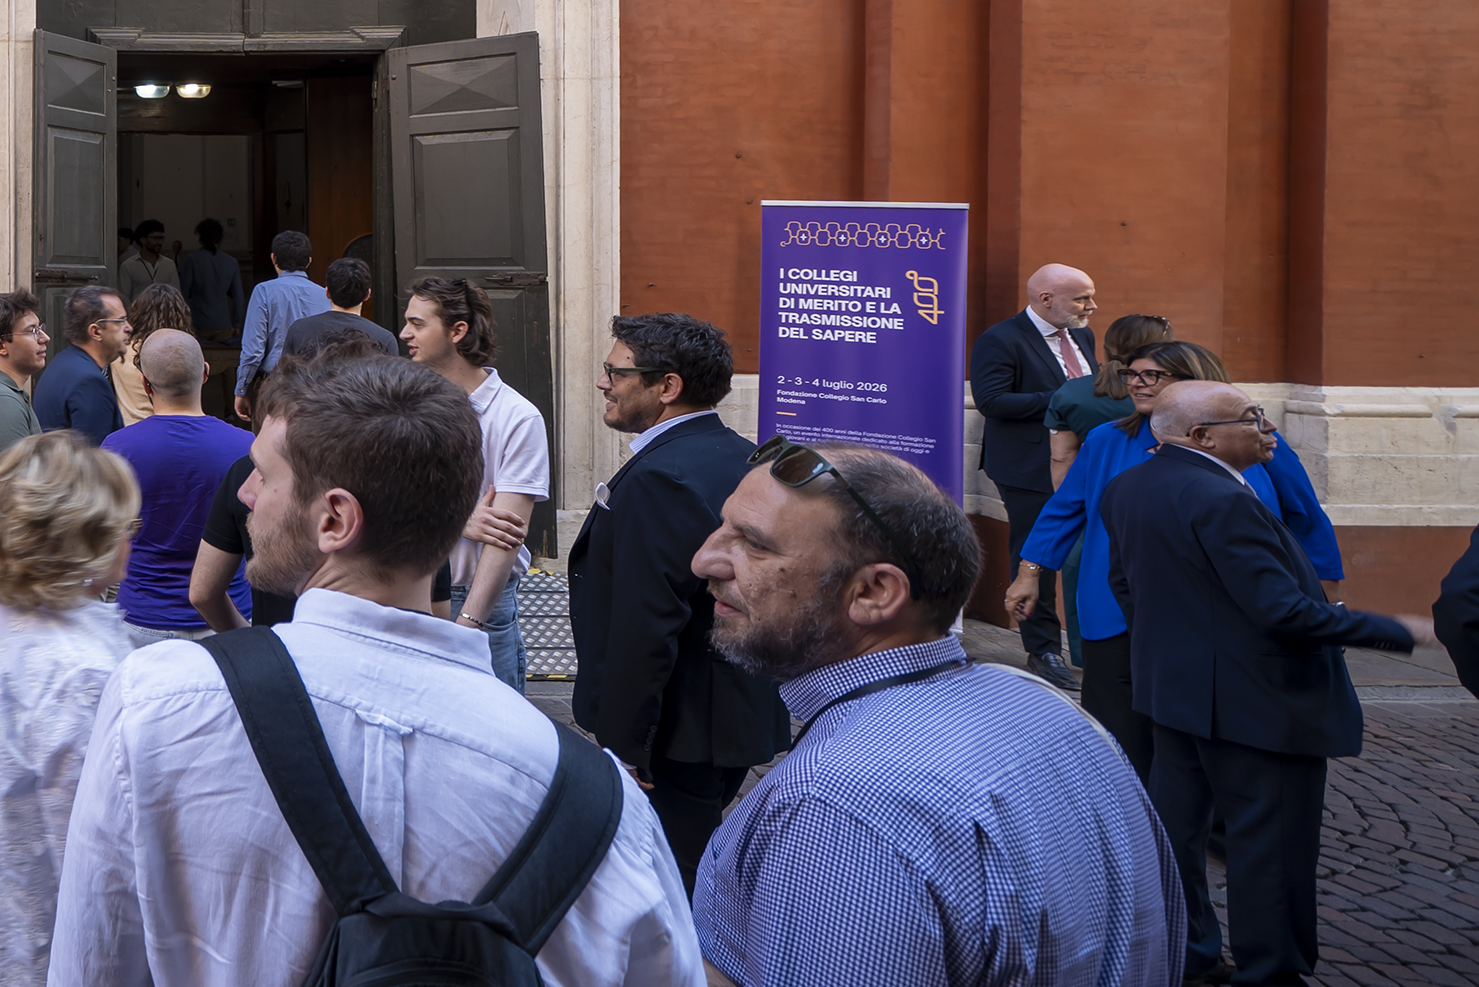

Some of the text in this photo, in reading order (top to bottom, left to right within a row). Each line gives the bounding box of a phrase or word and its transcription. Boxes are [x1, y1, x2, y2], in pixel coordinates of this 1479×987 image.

[780, 268, 858, 282] I COLLEGI
[779, 283, 891, 299] UNIVERSITARI
[779, 297, 902, 314] DI MERITO E LA
[778, 312, 904, 330] TRASMISSIONE
[778, 327, 877, 343] DEL SAPERE
[777, 375, 785, 384] 2
[794, 377, 802, 385] 3
[812, 378, 820, 386] 4
[822, 379, 854, 390] luglio
[856, 381, 888, 392] 2026
[777, 389, 817, 398] Fondazione
[819, 393, 849, 401] Collegio
[822, 433, 860, 441] internazionale
[900, 441, 934, 449] formazione
[863, 431, 897, 439] Fondazione
